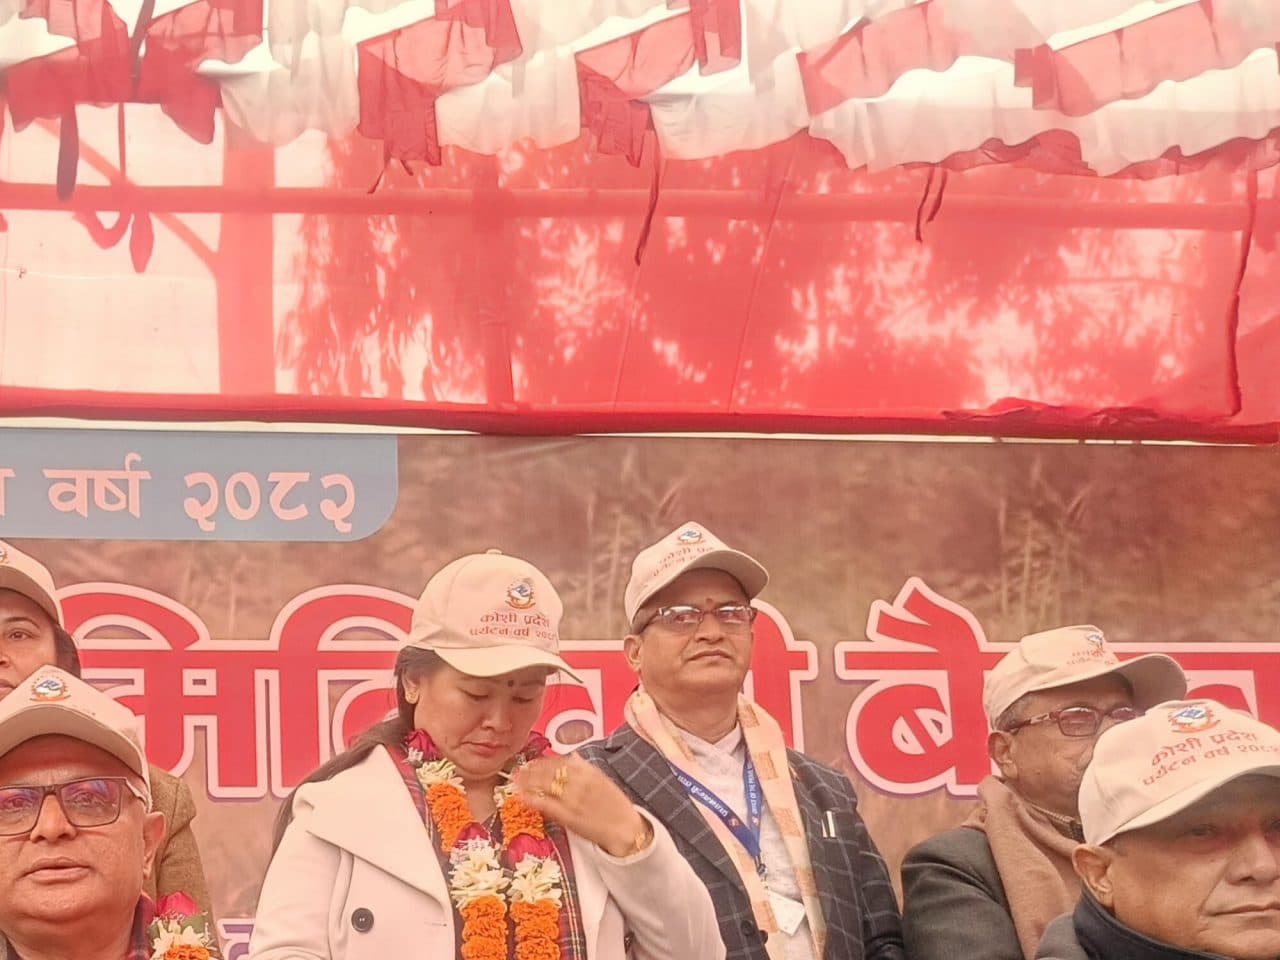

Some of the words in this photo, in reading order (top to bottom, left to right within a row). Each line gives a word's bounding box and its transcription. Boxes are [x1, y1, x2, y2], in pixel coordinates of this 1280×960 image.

[44, 452, 152, 518] वर्ष
[183, 470, 357, 534] २०८२
[480, 611, 517, 624] कोशी
[1152, 737, 1202, 767] कोशी
[1143, 754, 1197, 786] पर्यटन
